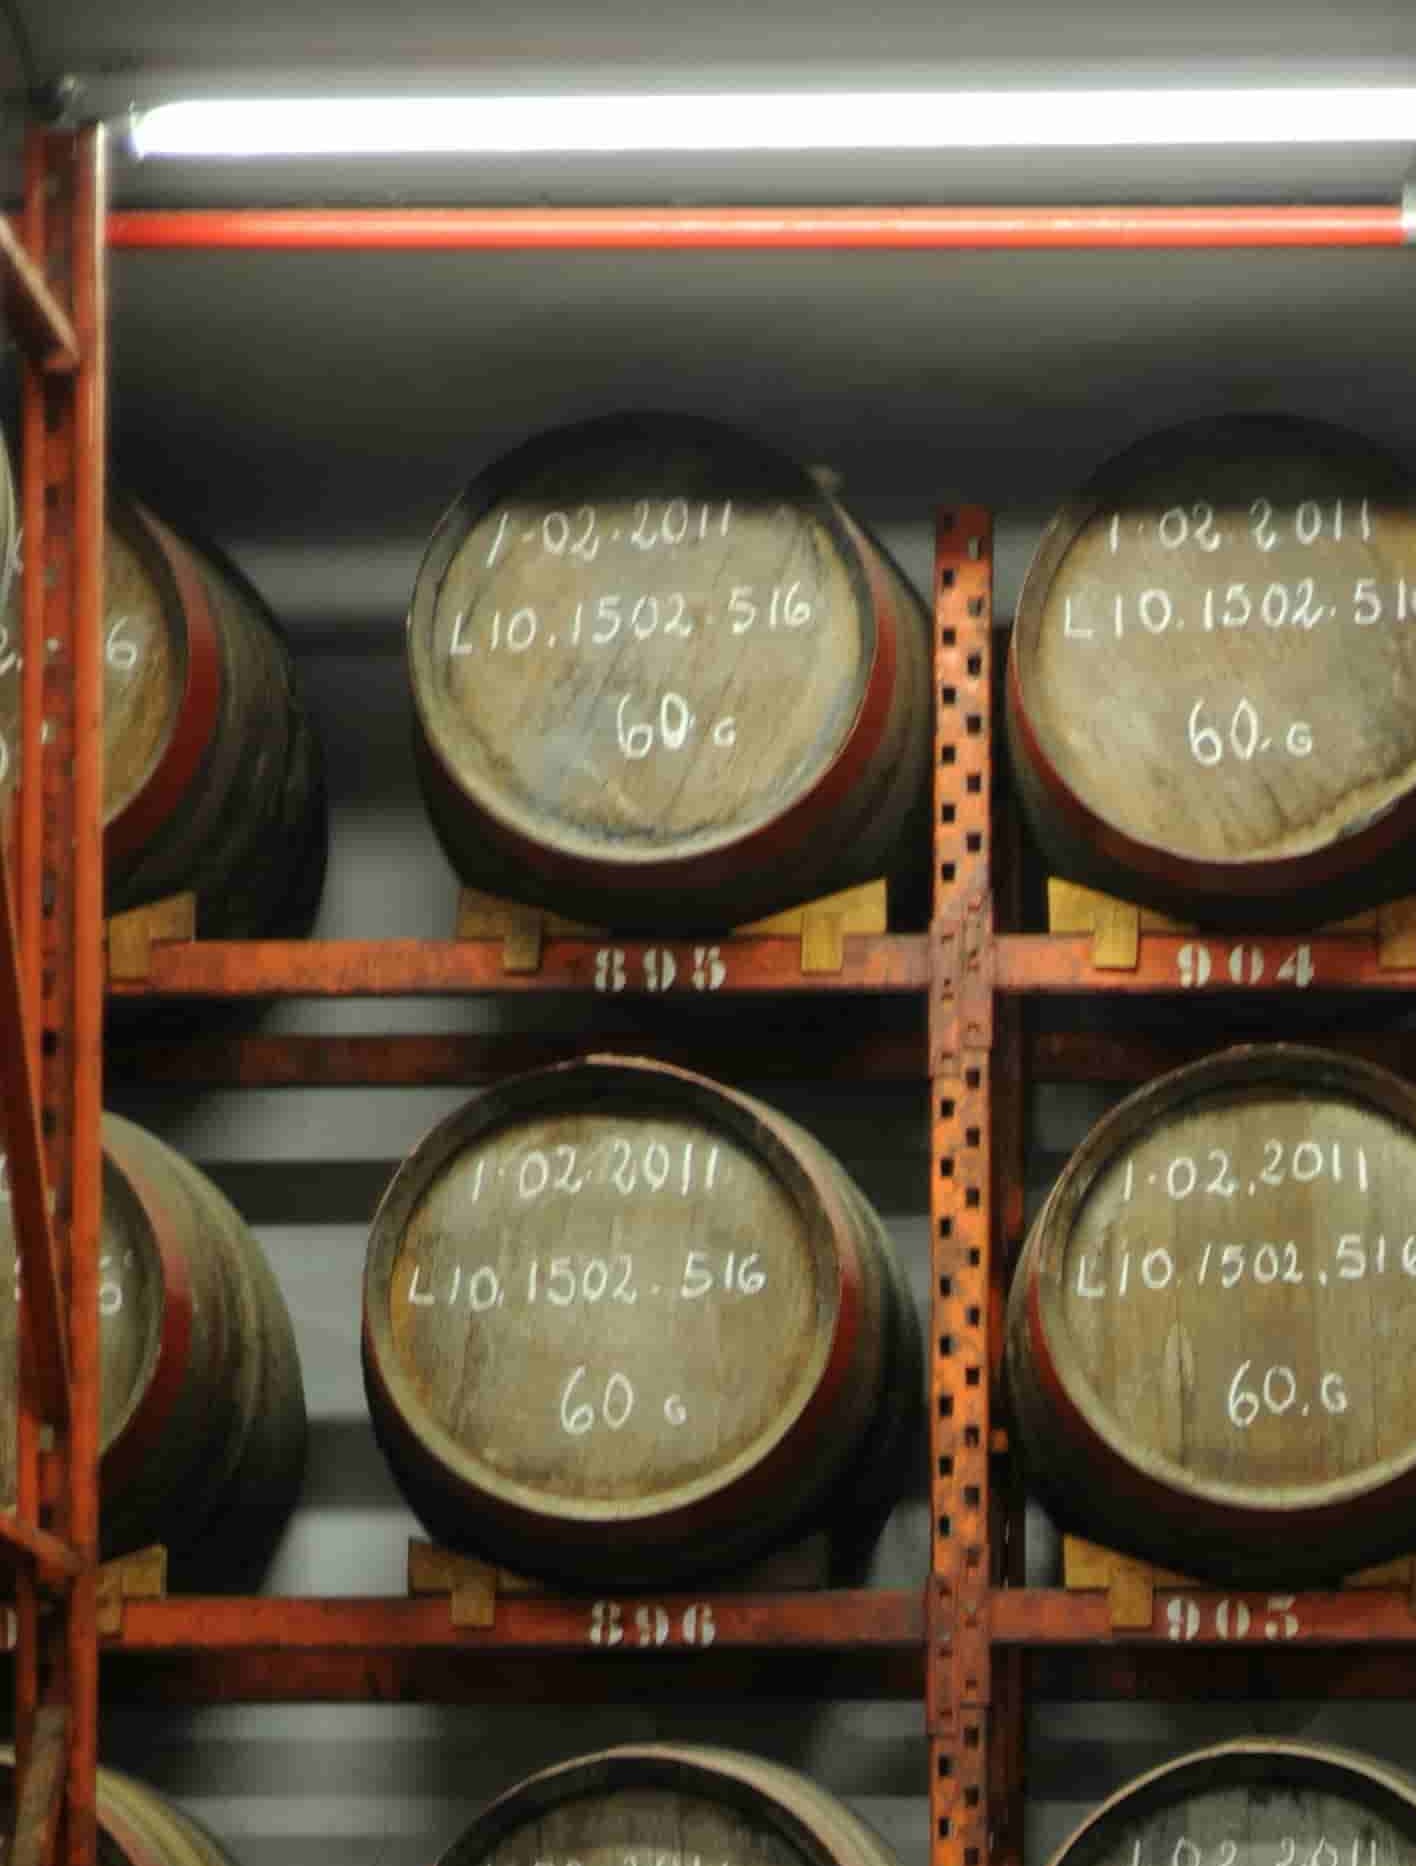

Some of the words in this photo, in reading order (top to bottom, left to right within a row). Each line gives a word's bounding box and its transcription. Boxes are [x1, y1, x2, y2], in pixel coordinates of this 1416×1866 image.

[594, 945, 726, 993] 895
[1175, 942, 1315, 988] 904
[589, 1600, 716, 1647] 896
